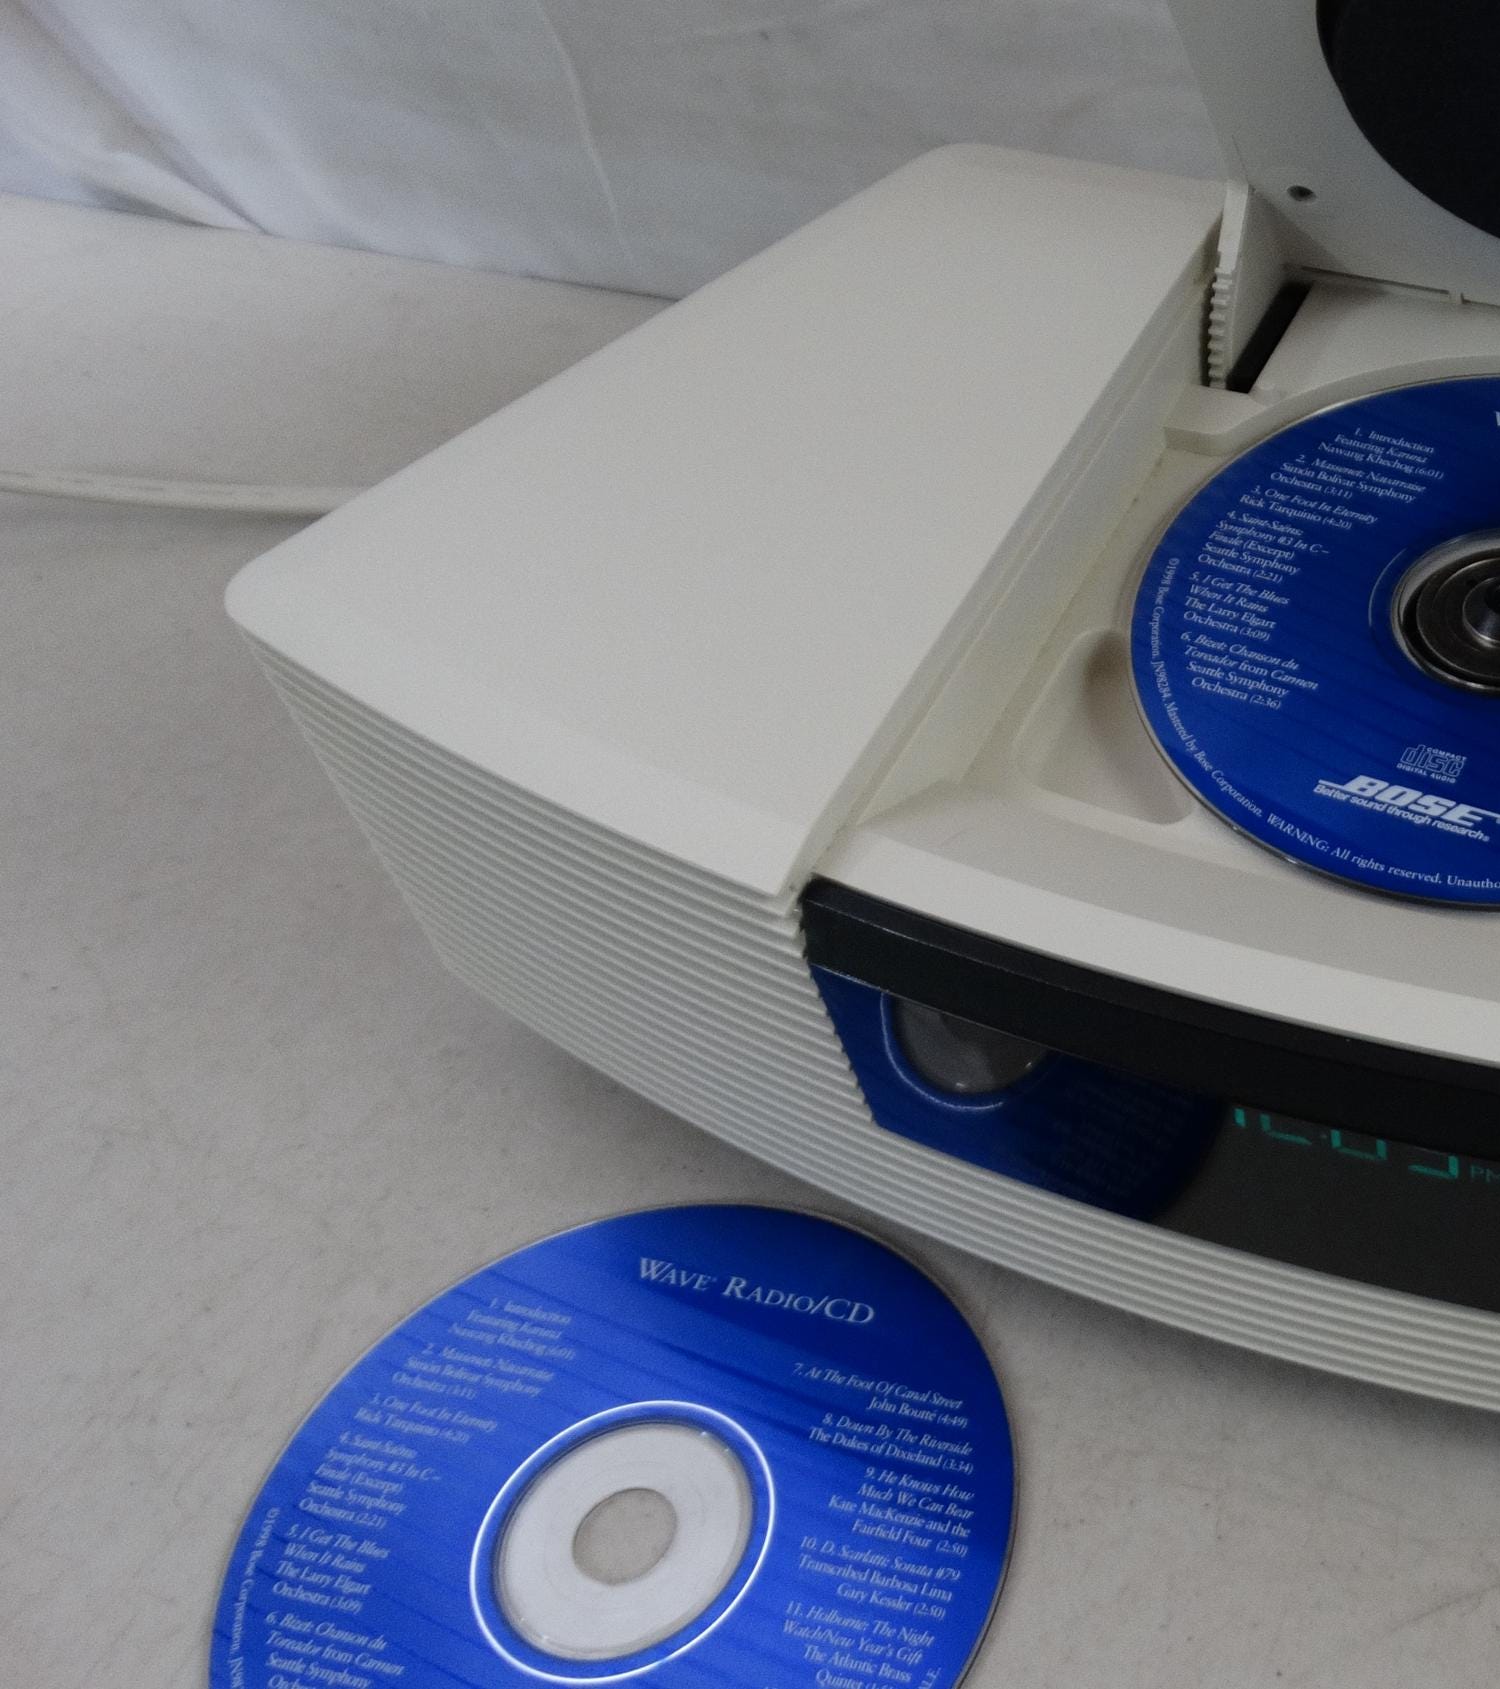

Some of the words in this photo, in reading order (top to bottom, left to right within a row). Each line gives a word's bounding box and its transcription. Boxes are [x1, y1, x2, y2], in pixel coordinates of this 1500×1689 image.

[1164, 701, 1194, 741] Mastered
[1185, 739, 1198, 753] by
[1194, 751, 1213, 771] Bose
[1267, 812, 1329, 852] WARNING:
[1330, 847, 1350, 860] All
[1351, 854, 1385, 871] rights
[1388, 865, 1442, 884] reserved.
[1396, 762, 1427, 776] DIGITAL
[1430, 772, 1456, 784] AUDIO
[1313, 784, 1349, 801] Better
[1350, 796, 1388, 812] sound
[1386, 804, 1432, 825] through
[723, 1276, 876, 1324] RADIO/CD
